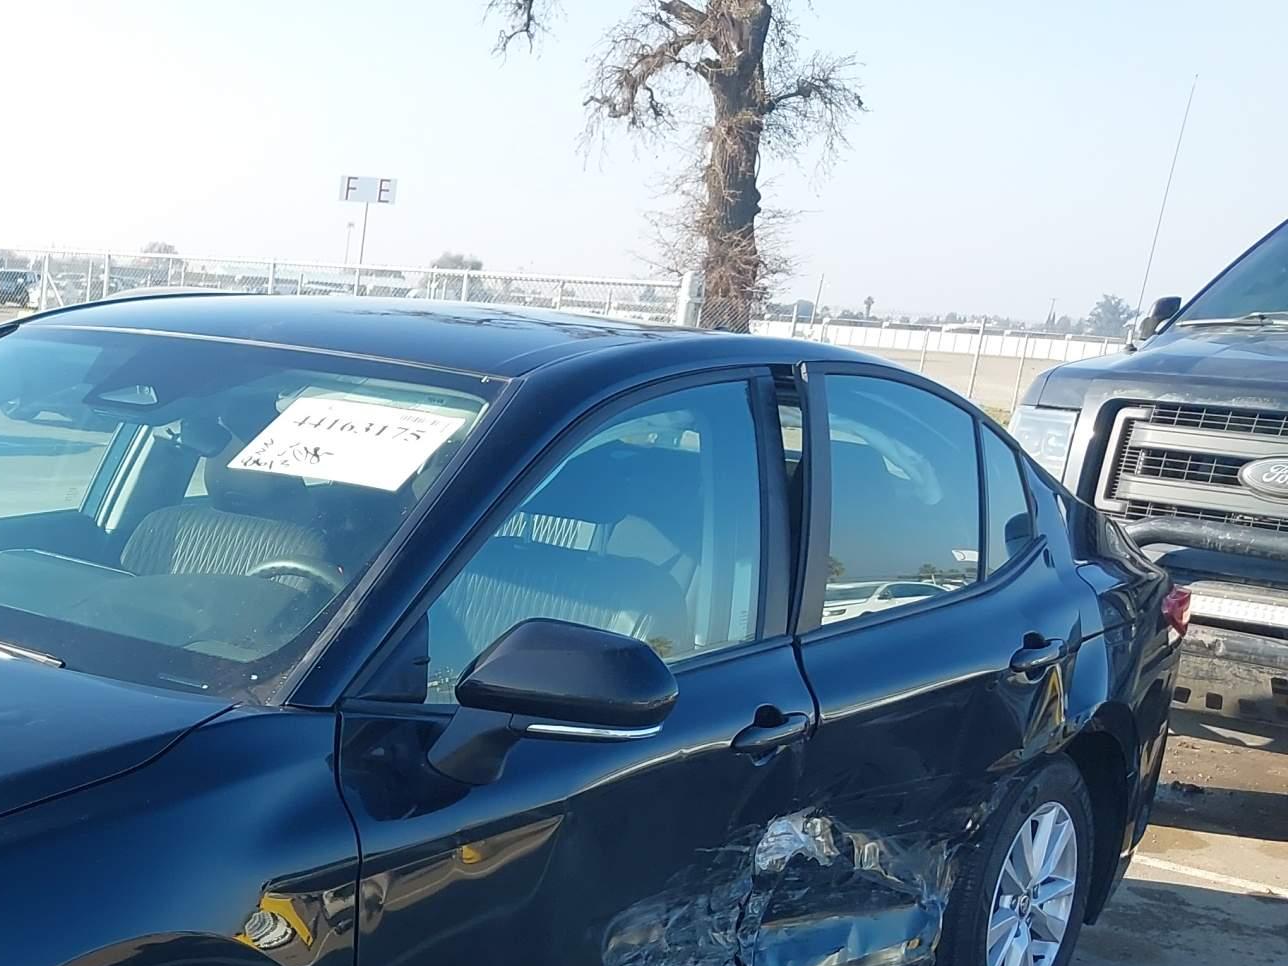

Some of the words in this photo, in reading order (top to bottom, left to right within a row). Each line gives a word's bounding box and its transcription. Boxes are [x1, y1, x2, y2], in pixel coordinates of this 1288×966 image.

[345, 176, 359, 201] F
[377, 179, 391, 203] E
[293, 415, 426, 442] 44163175
